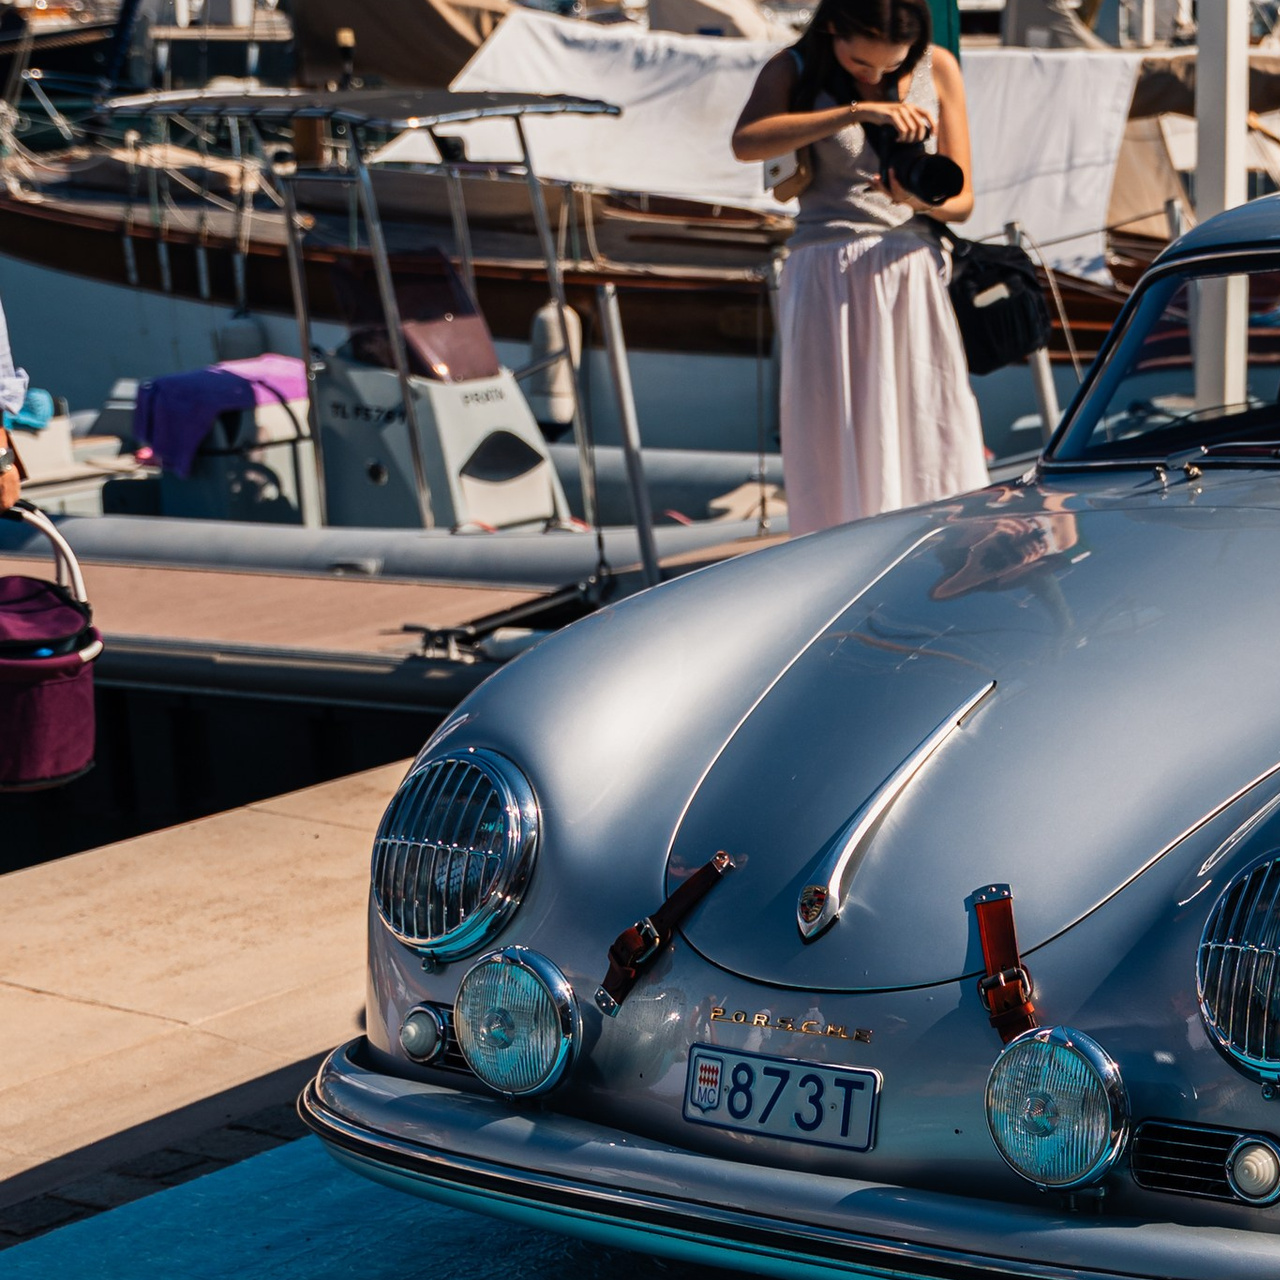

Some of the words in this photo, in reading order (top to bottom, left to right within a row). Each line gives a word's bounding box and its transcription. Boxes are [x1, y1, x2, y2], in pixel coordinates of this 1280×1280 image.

[710, 1007, 873, 1043] PORSCHE
[697, 1087, 716, 1105] MC
[727, 1062, 865, 1138] 873T
